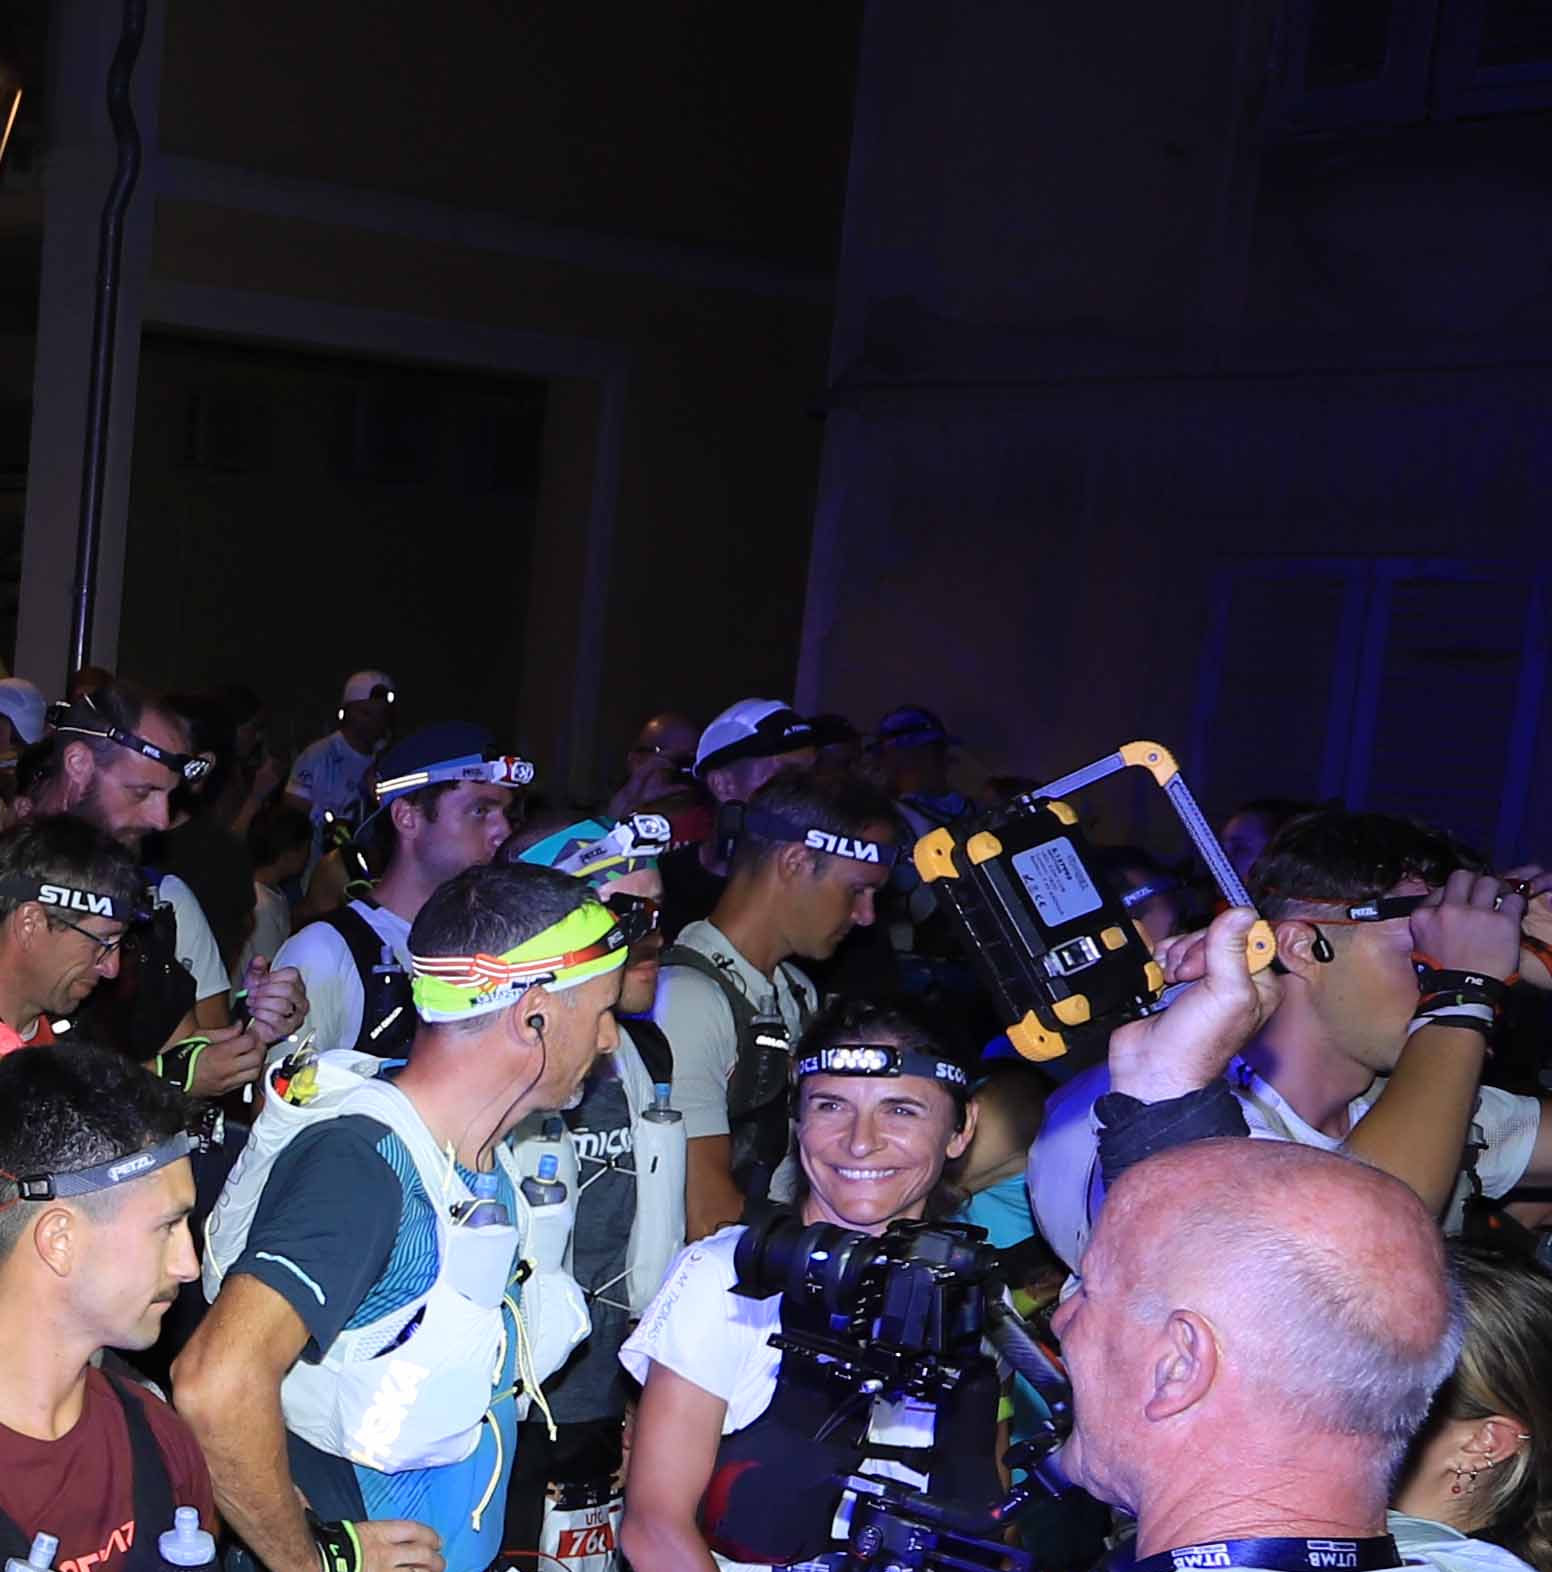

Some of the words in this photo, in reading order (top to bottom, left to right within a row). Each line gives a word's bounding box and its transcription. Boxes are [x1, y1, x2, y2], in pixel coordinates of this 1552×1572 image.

[805, 829, 880, 863] SILVA
[38, 884, 114, 917] SILVA
[107, 1155, 157, 1182] PETZL
[1172, 1551, 1231, 1569] UTMB
[1307, 1551, 1357, 1568] UTMB
